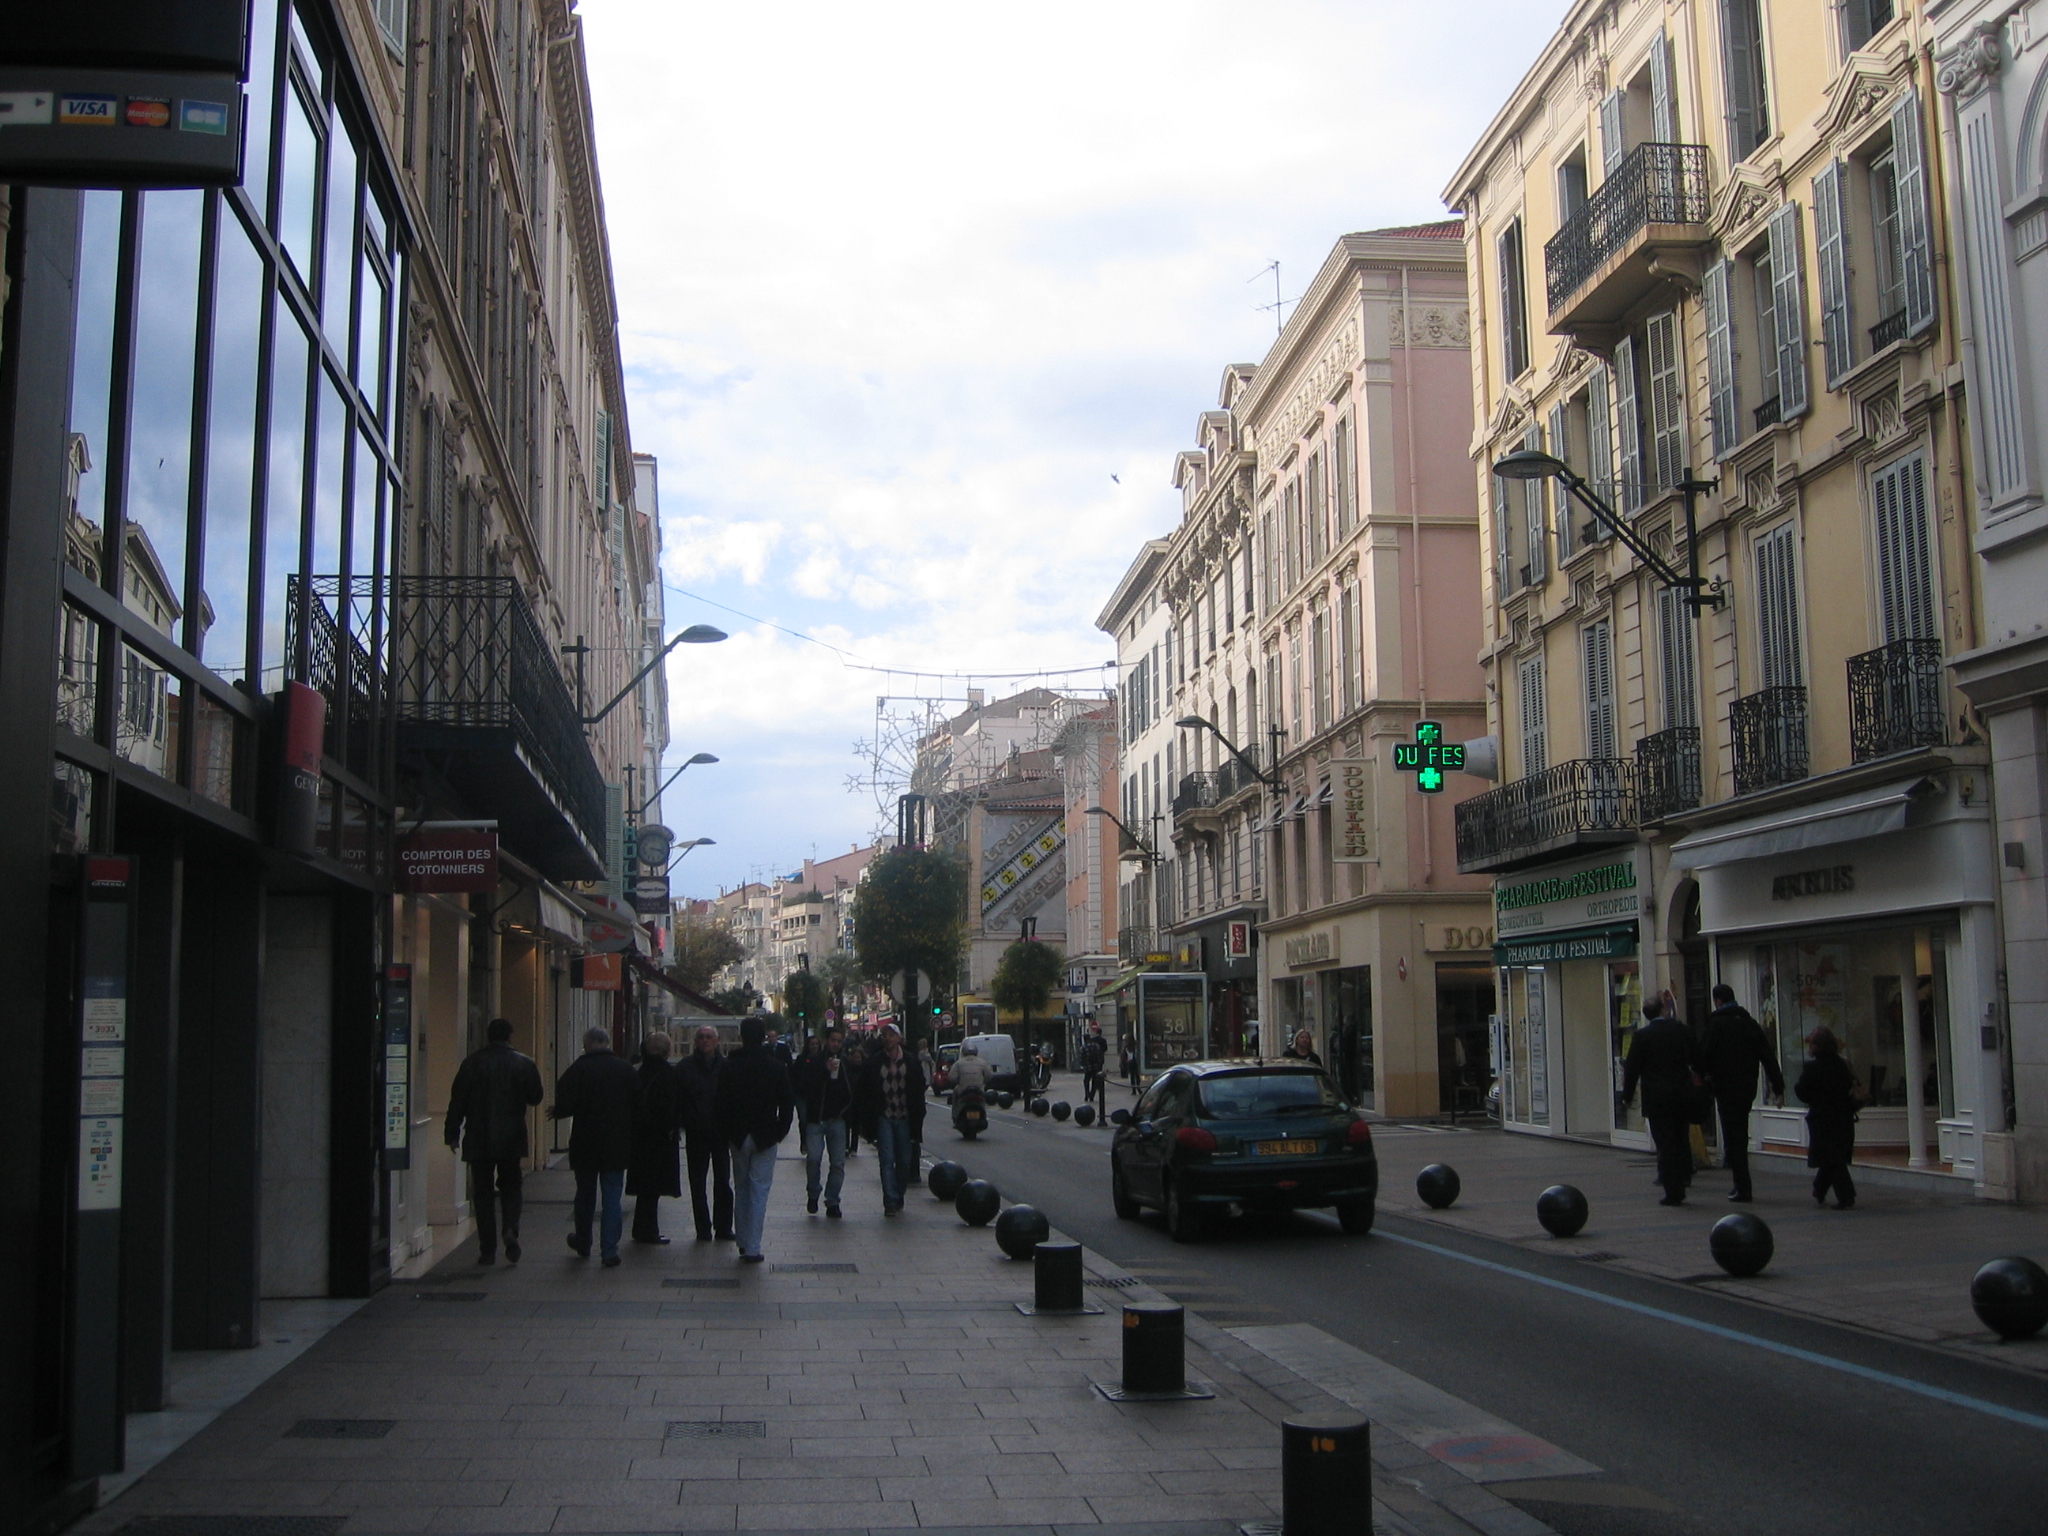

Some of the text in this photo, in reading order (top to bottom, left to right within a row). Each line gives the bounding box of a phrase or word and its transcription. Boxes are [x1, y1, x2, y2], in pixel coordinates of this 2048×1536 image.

[69, 101, 108, 116] VISA
[127, 109, 169, 120] MasterCard
[1343, 766, 1368, 857] DOCKLAND
[401, 849, 491, 861] COMPTOIR DES
[408, 864, 485, 875] COTONNIERS
[1496, 877, 1561, 911] PHARMACIE
[1572, 861, 1637, 897] FESTIVAL
[1587, 895, 1639, 917] ORTHOPEDIE
[1507, 938, 1612, 962] PHARMACIE DU FESTIVAL
[1164, 1018, 1184, 1034] 38
[1149, 1033, 1162, 1041] The
